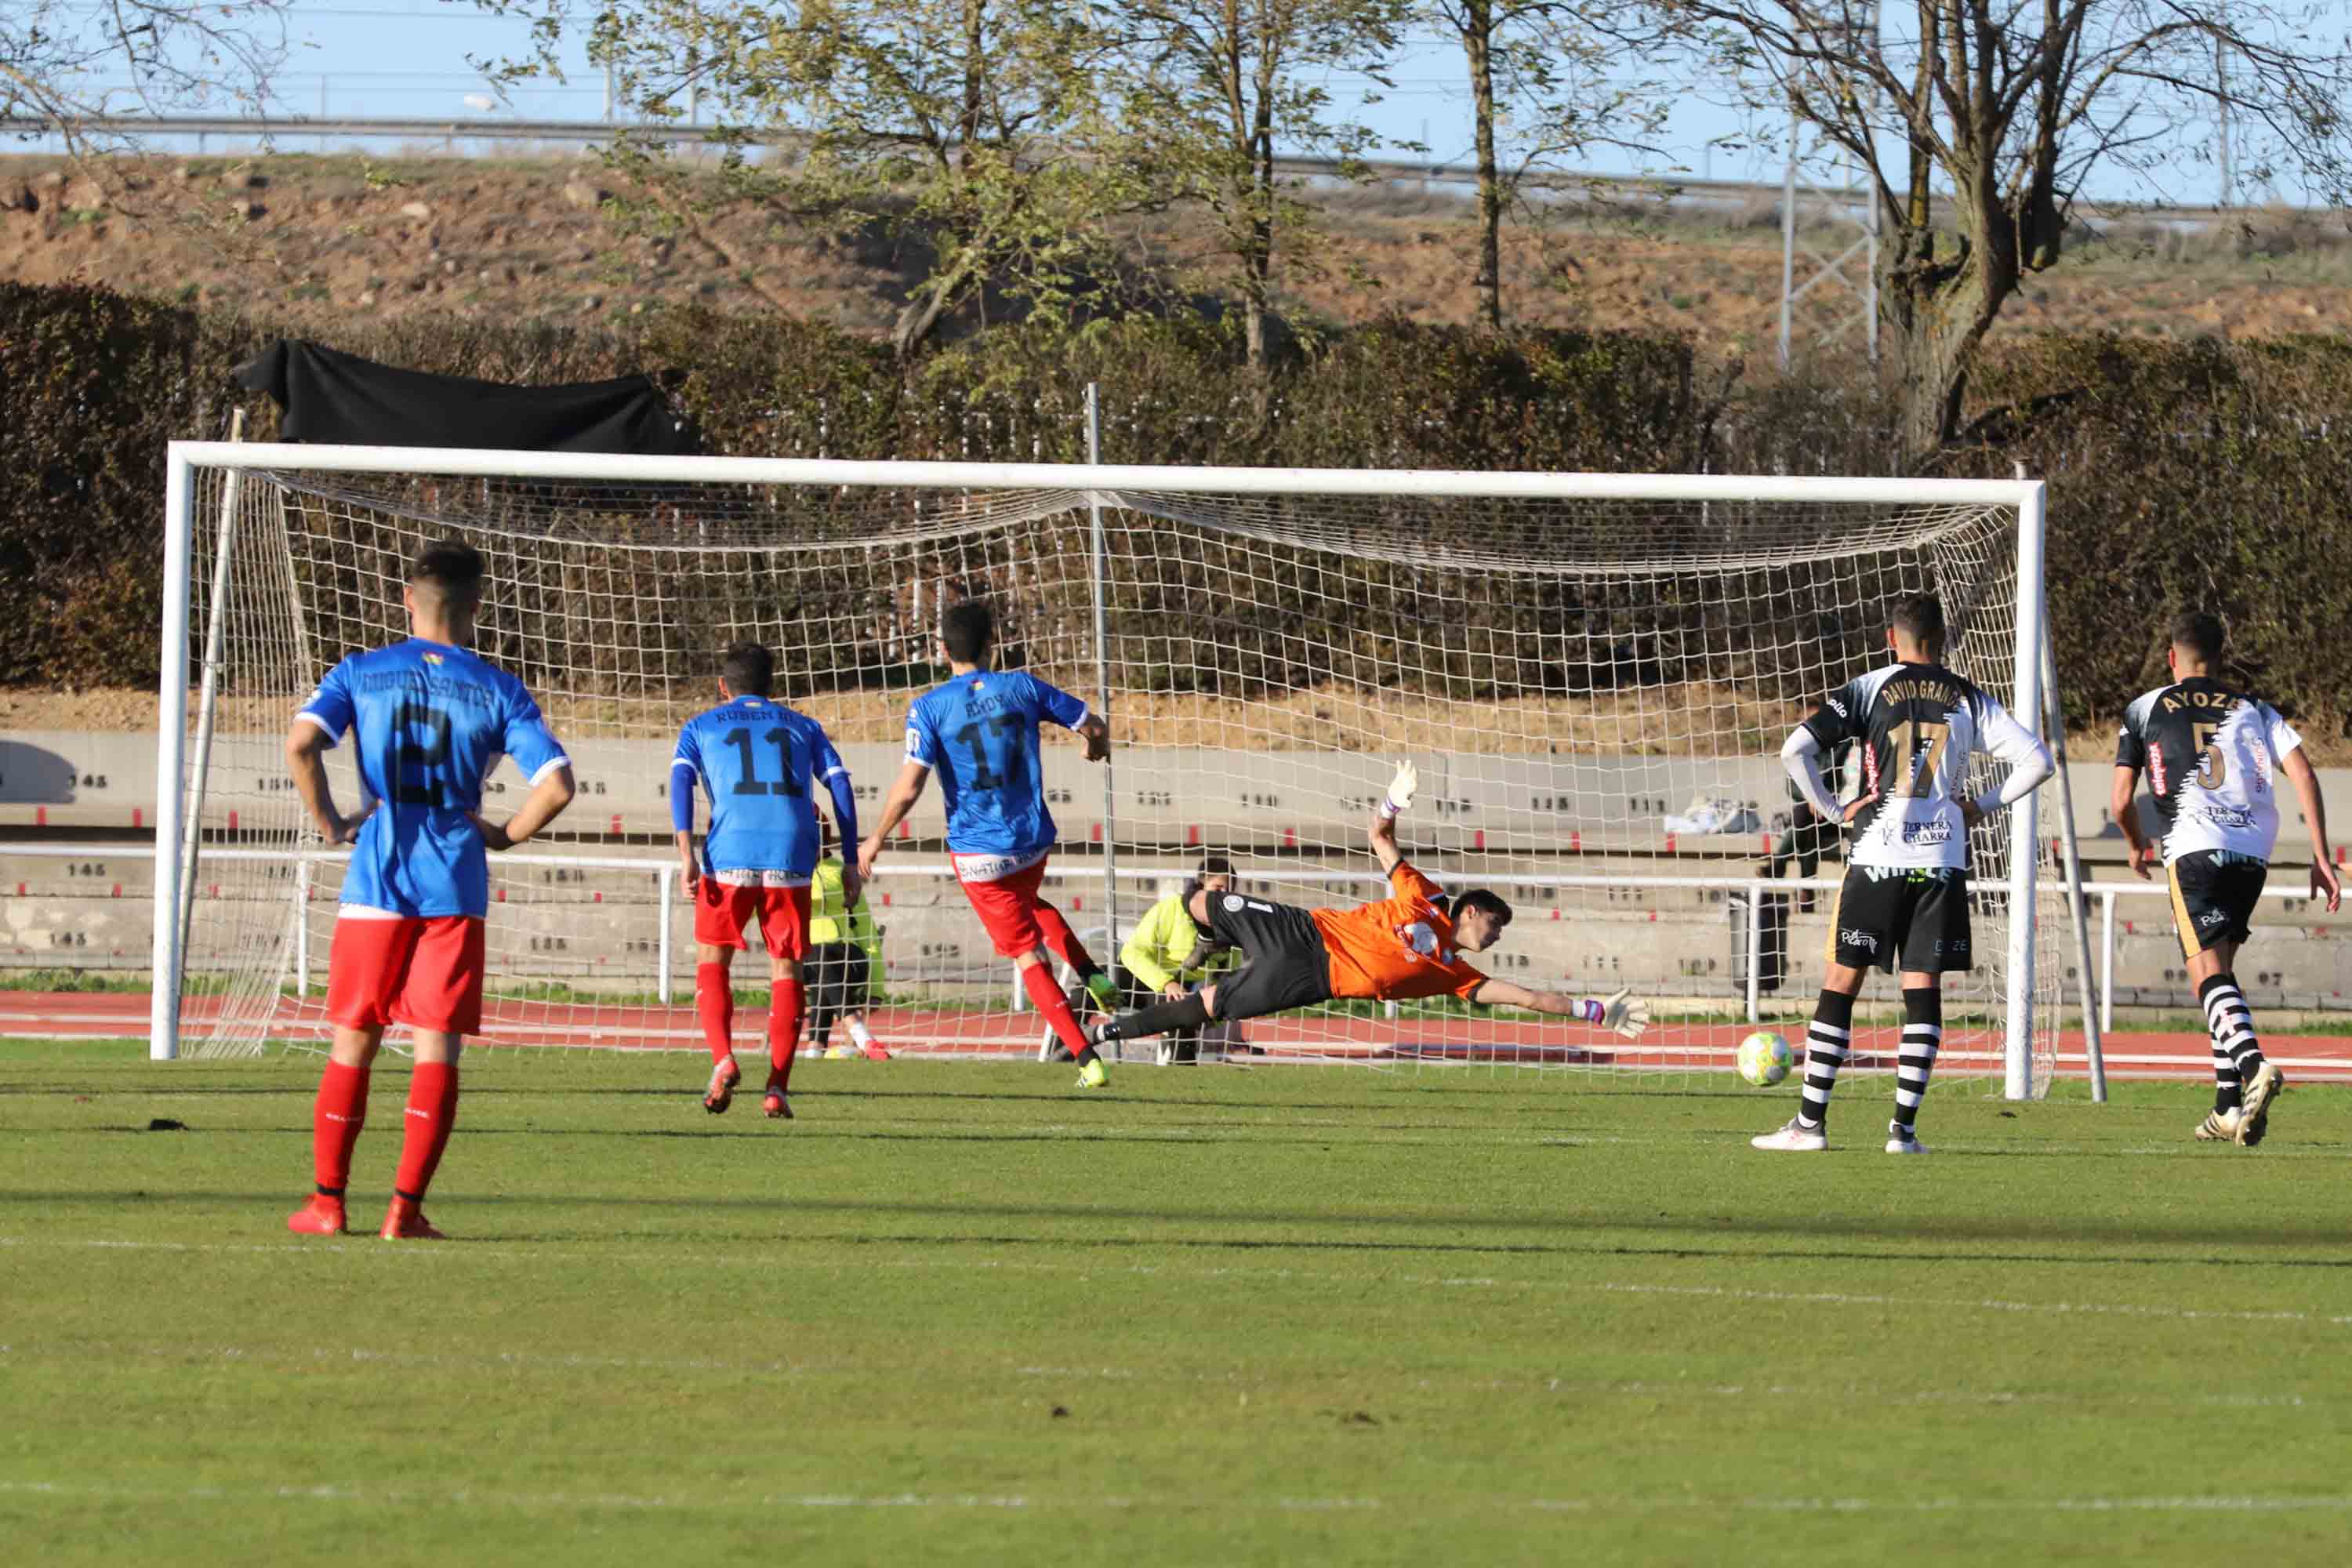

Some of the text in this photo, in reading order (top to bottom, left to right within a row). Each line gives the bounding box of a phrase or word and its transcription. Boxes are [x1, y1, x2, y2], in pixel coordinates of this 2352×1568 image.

[1882, 680, 1917, 706] DAVID
[722, 727, 804, 798] 11
[956, 710, 1029, 791] 17
[1887, 720, 1950, 798] 17
[2192, 721, 2226, 790] 5
[1903, 820, 1953, 833] TERNERA
[1903, 831, 1952, 844] CHARRA
